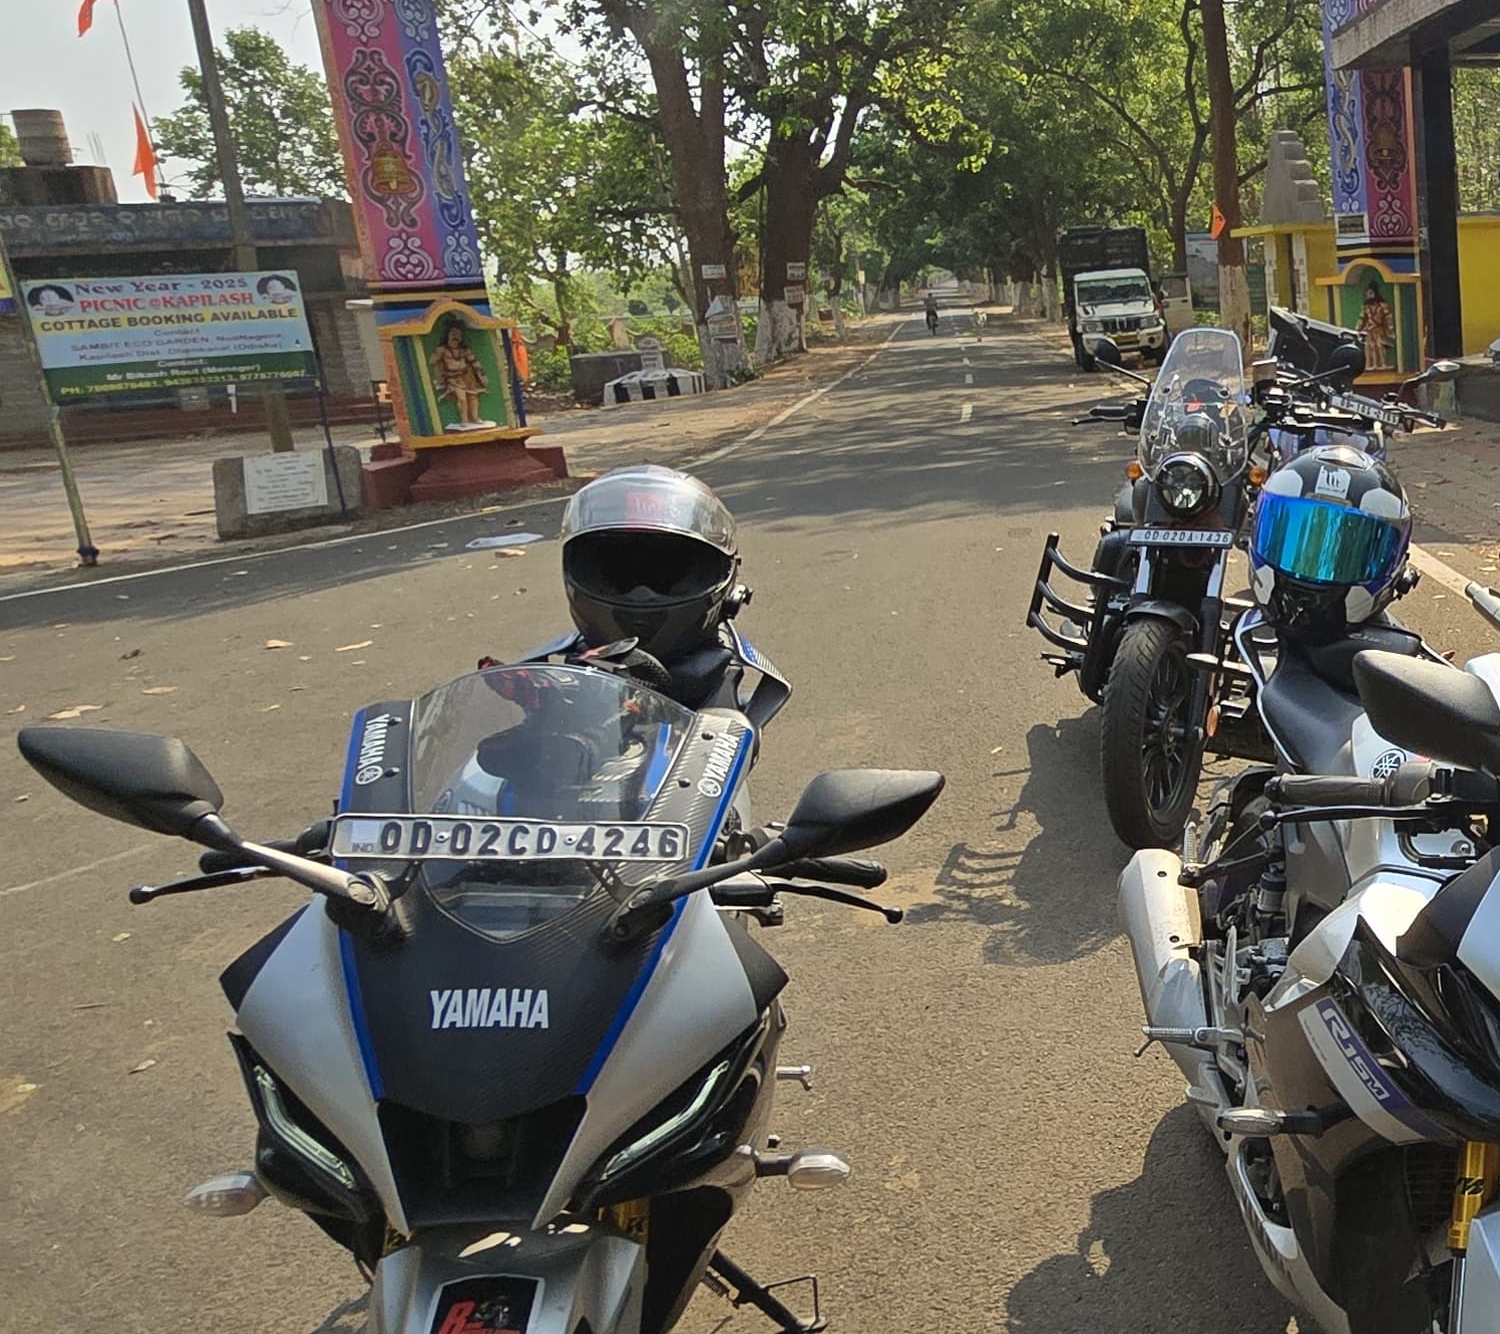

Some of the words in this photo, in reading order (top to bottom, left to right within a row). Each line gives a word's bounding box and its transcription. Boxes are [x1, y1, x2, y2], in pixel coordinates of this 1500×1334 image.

[74, 282, 124, 296] New
[130, 279, 181, 293] Year
[200, 277, 249, 290] 2025
[40, 317, 122, 333] COTTAGE
[127, 312, 206, 327] BOOKING
[210, 307, 299, 322] AVAILABLE
[79, 297, 147, 313] PICNIC
[702, 731, 740, 782] YAMAHA
[430, 988, 549, 1029] YAMAHA
[1322, 1007, 1391, 1102] R15M
